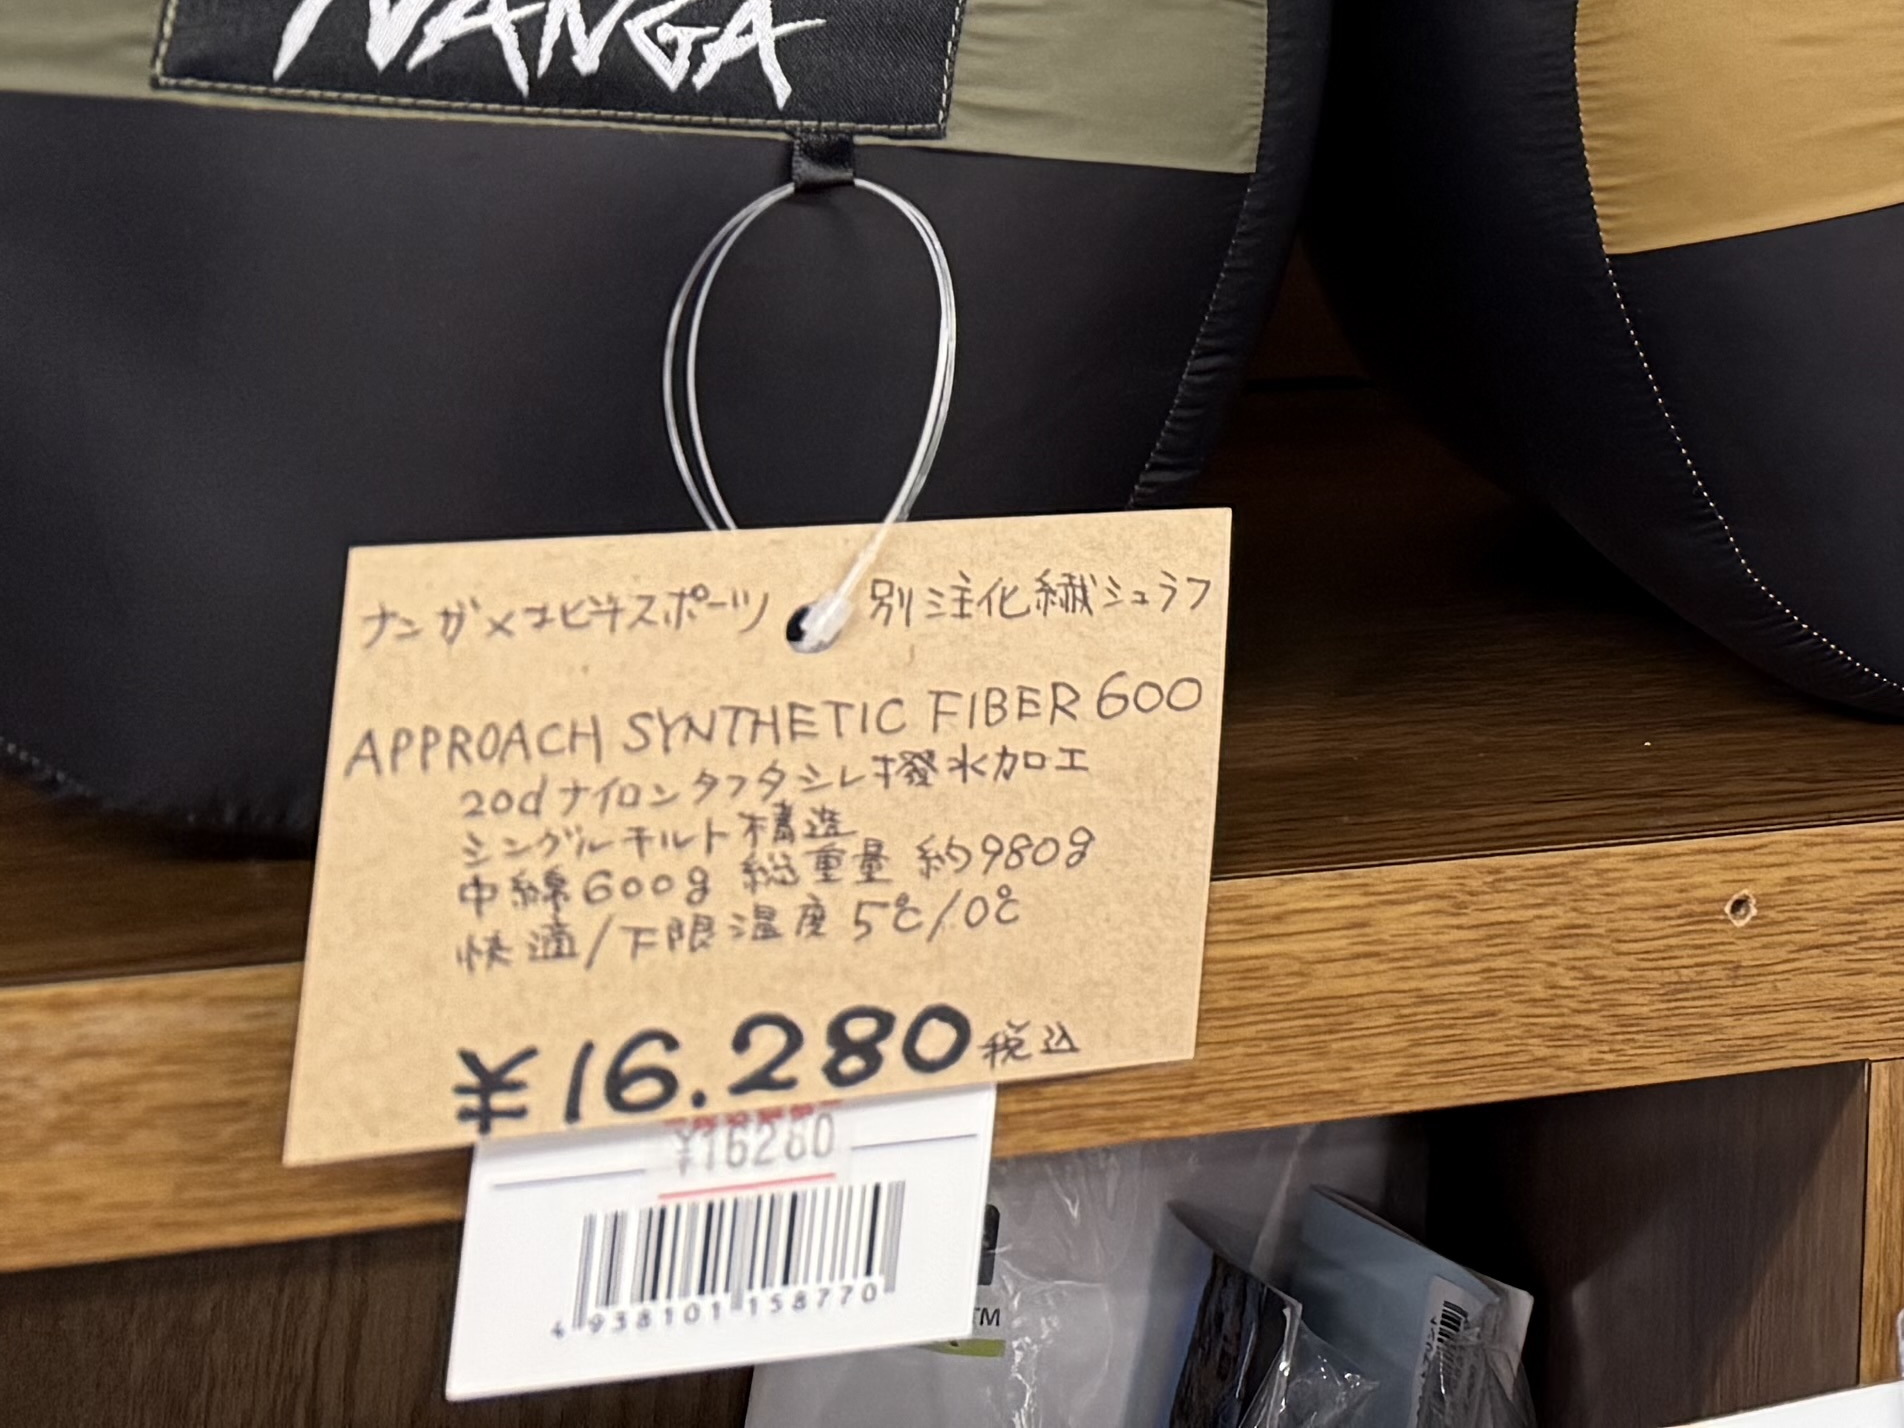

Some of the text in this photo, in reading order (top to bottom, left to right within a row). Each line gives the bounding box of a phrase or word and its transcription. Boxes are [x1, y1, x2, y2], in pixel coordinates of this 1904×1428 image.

[344, 671, 1202, 777] APPROACH SYNTHETIC FIBER 600
[979, 1021, 1081, 1070] 税込
